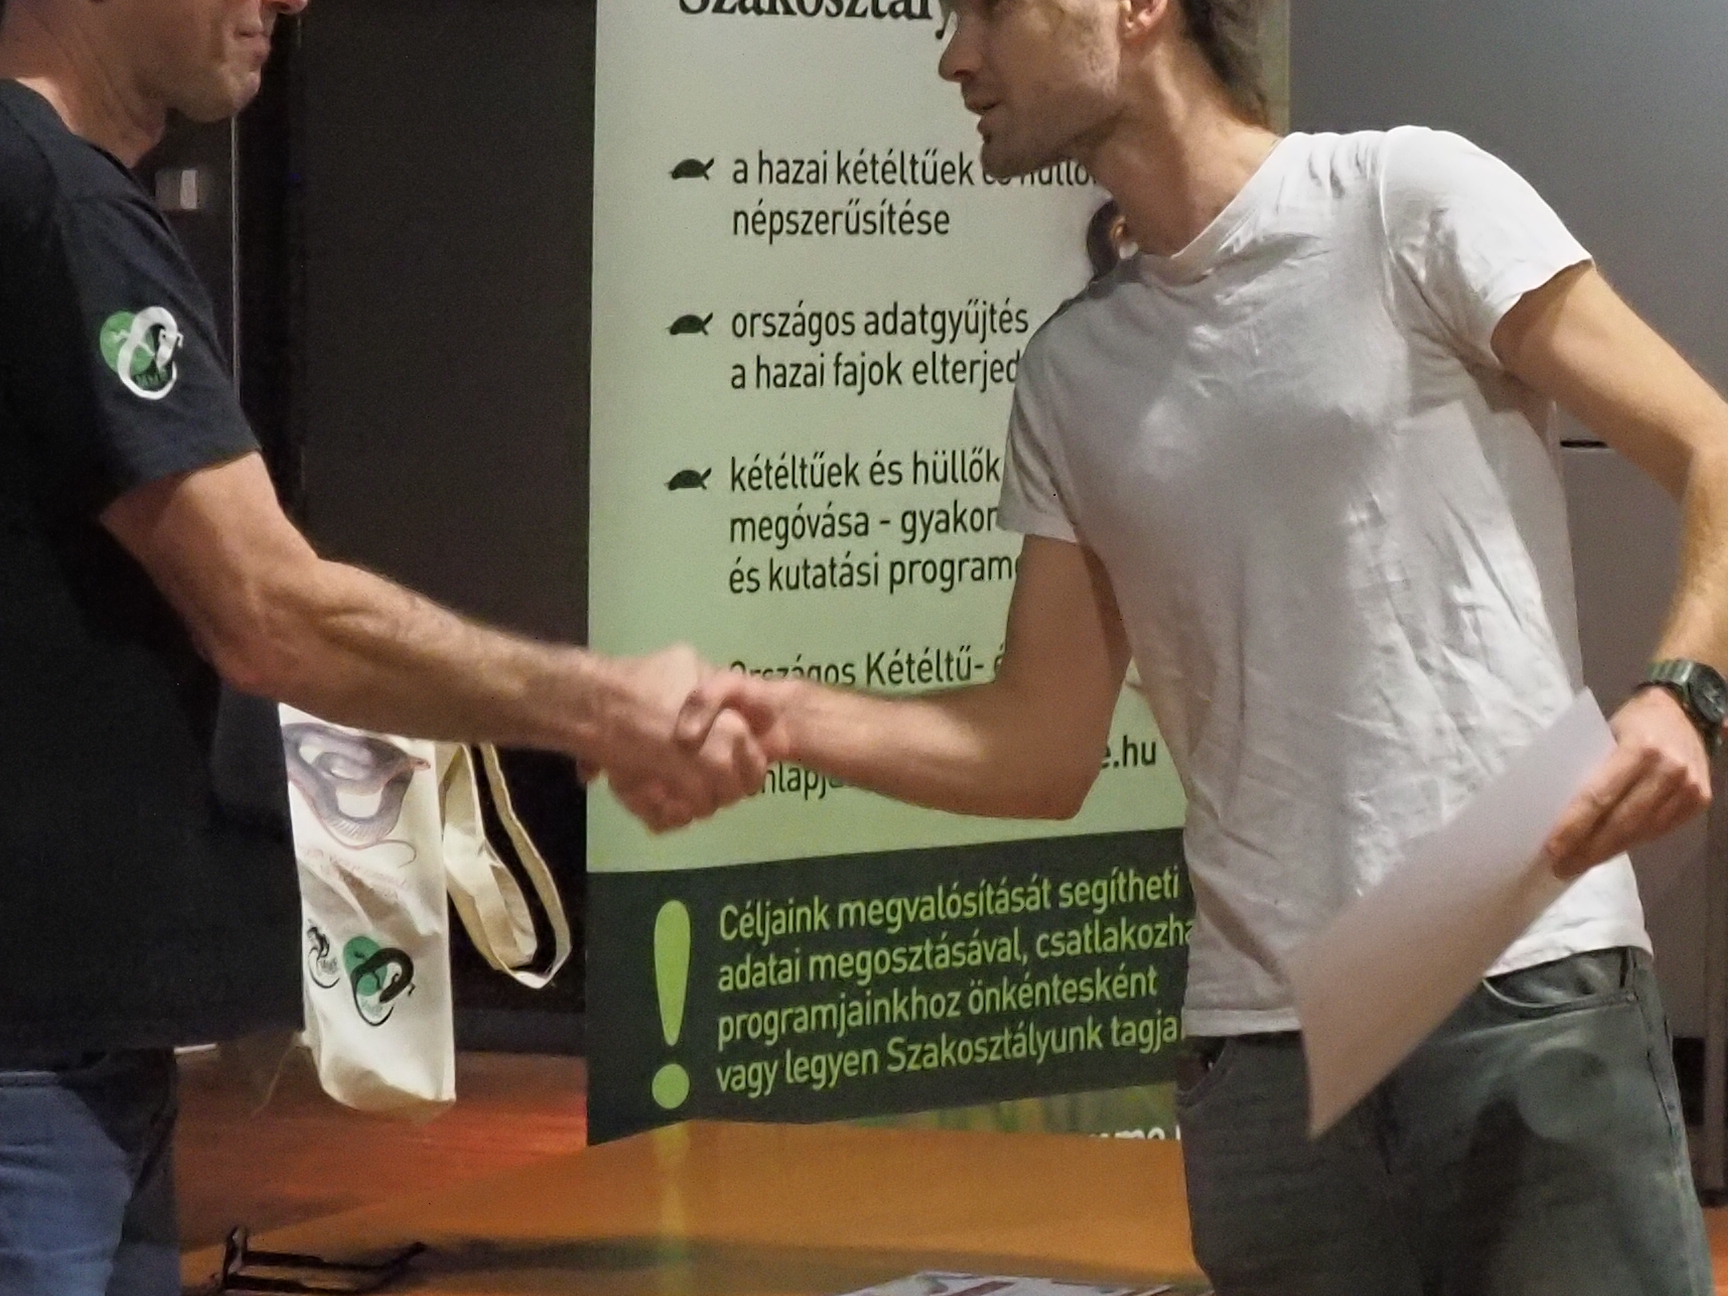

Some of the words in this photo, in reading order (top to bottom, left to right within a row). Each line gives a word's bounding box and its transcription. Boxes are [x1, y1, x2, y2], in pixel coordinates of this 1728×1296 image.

[733, 158, 748, 184] a
[758, 149, 827, 184] hazai
[837, 148, 974, 186] kétéltűek
[733, 198, 951, 245] népszerűsítése
[732, 299, 855, 346] országos
[864, 297, 1029, 344] adatgyűjtés
[731, 363, 746, 389] a
[756, 352, 825, 389] hazai
[834, 351, 902, 396] fajok
[731, 451, 860, 492] kétéltűek
[869, 449, 903, 485] és
[913, 447, 1000, 484] hüllők
[730, 501, 869, 550] megóvása
[729, 556, 760, 594] és
[769, 550, 879, 591] kutatási
[890, 554, 1017, 595] program
[867, 645, 984, 686] Kétéltű-
[720, 895, 831, 946] Céljaink
[837, 873, 1051, 934] megvalósítását
[1058, 865, 1179, 914] segítheti
[718, 947, 800, 991] adatai
[809, 926, 1028, 986] megosztásával,
[718, 986, 961, 1052] programjainkhoz
[968, 962, 1158, 1016] önkéntesként
[716, 1059, 778, 1099] vagy
[786, 1047, 878, 1090] legyen
[887, 1014, 1103, 1073] Szakosztályunk
[1111, 1008, 1178, 1054] tagja
